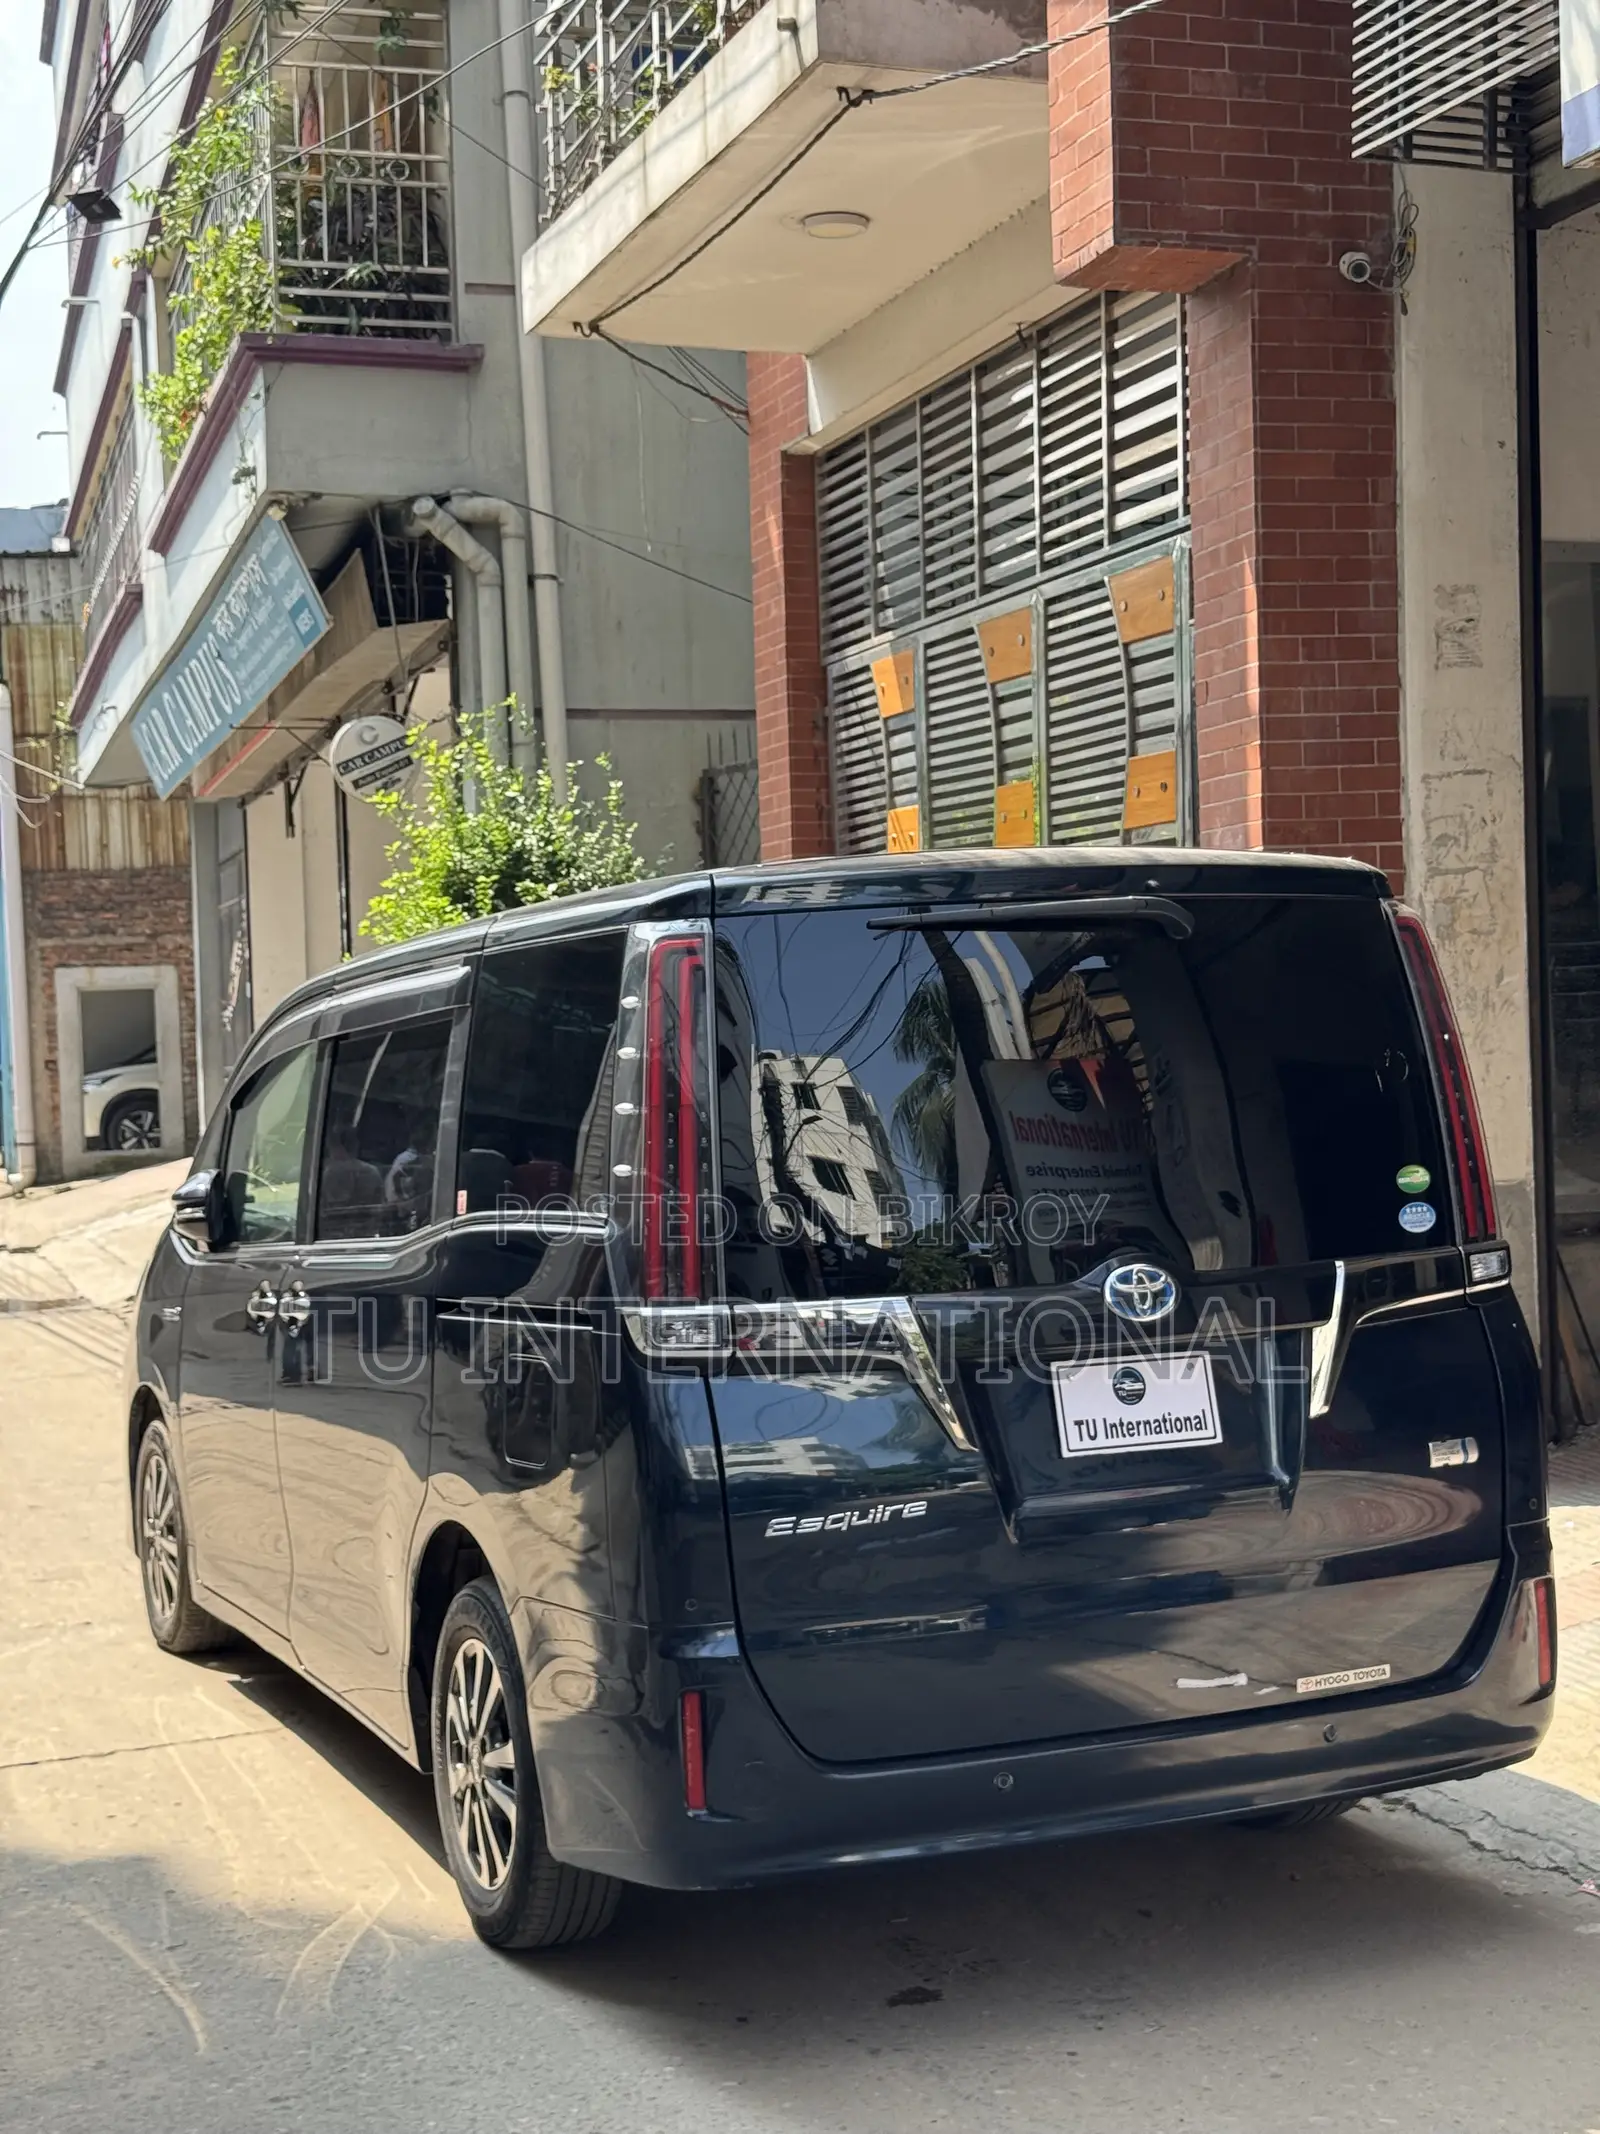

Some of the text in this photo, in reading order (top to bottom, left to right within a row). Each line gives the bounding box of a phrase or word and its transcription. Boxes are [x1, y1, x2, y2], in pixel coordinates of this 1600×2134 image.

[139, 631, 242, 782] CAR CAMPUS
[339, 759, 364, 774] CAR
[365, 738, 407, 764] CAMPU
[1074, 1408, 1208, 1442] TU International
[764, 1501, 928, 1537] Esquire
[1315, 1667, 1387, 1687] HYOGO TOYOTA
